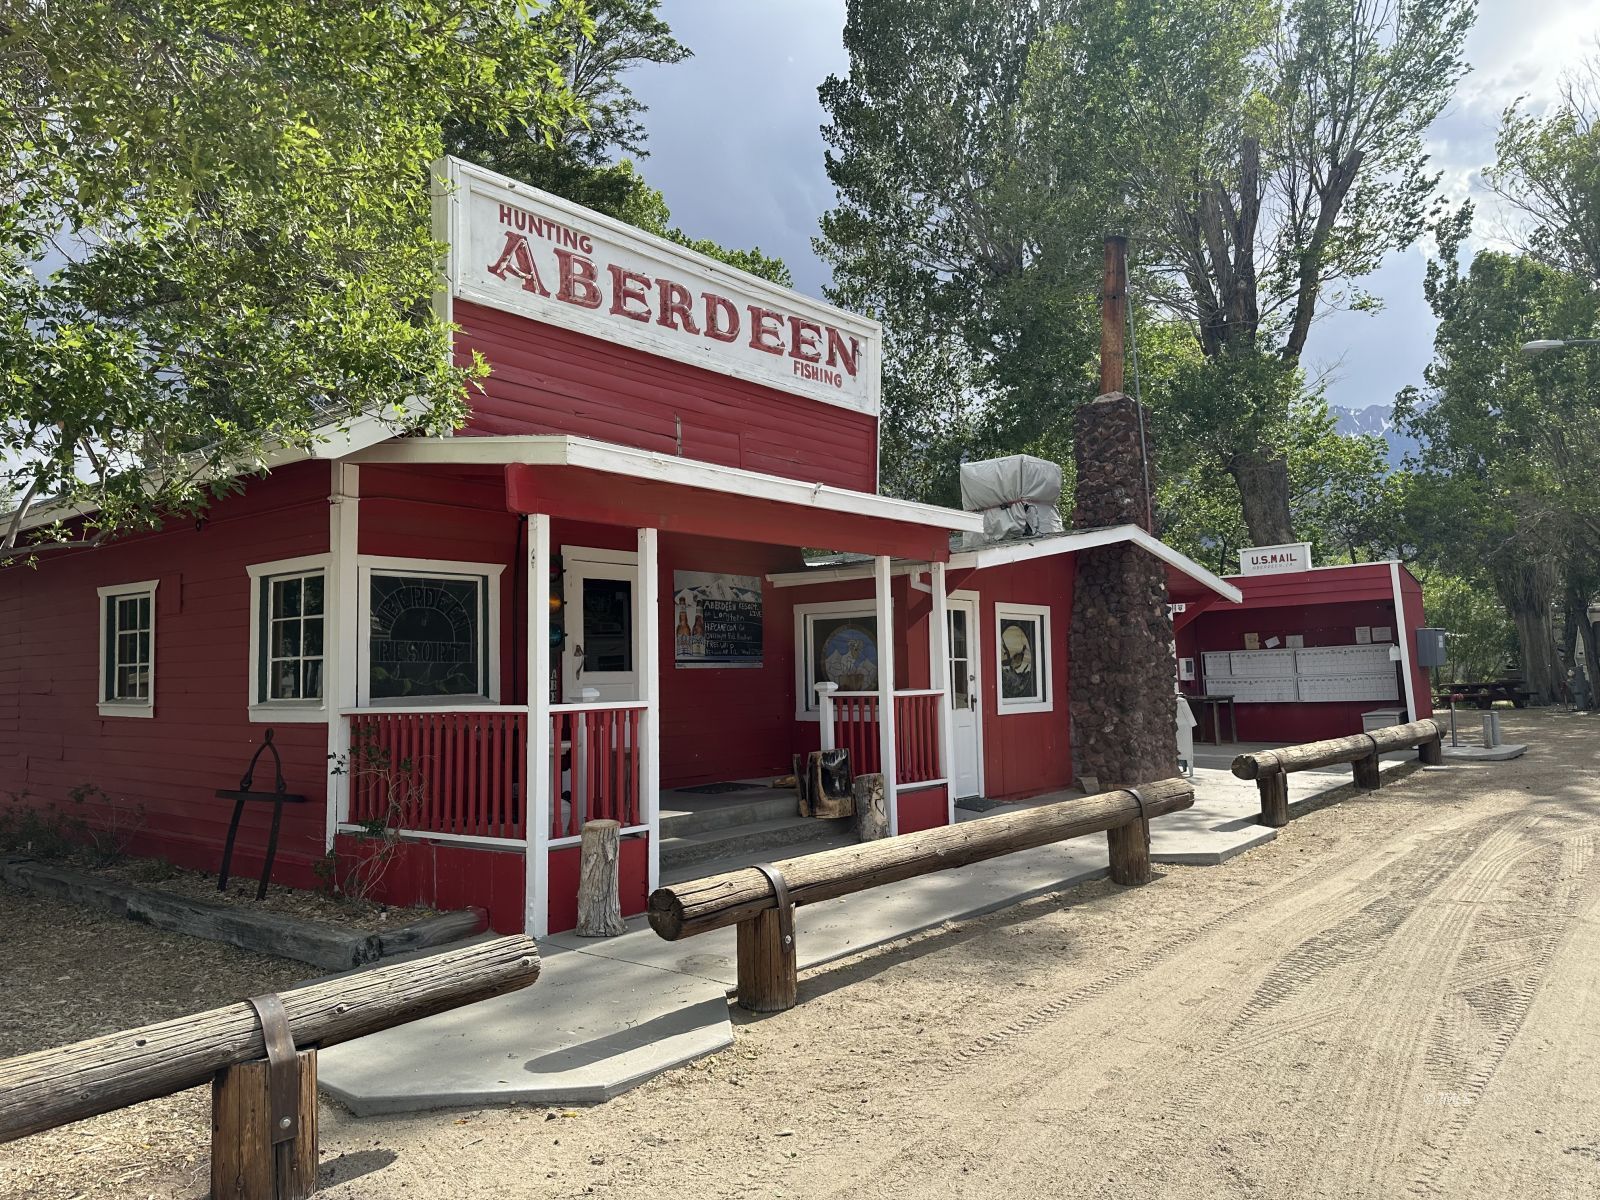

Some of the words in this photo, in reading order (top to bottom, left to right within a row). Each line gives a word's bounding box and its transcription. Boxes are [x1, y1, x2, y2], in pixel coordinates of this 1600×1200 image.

[499, 204, 593, 255] HUNTING
[487, 231, 860, 377] ABERDEEN
[793, 360, 842, 389] FISHING
